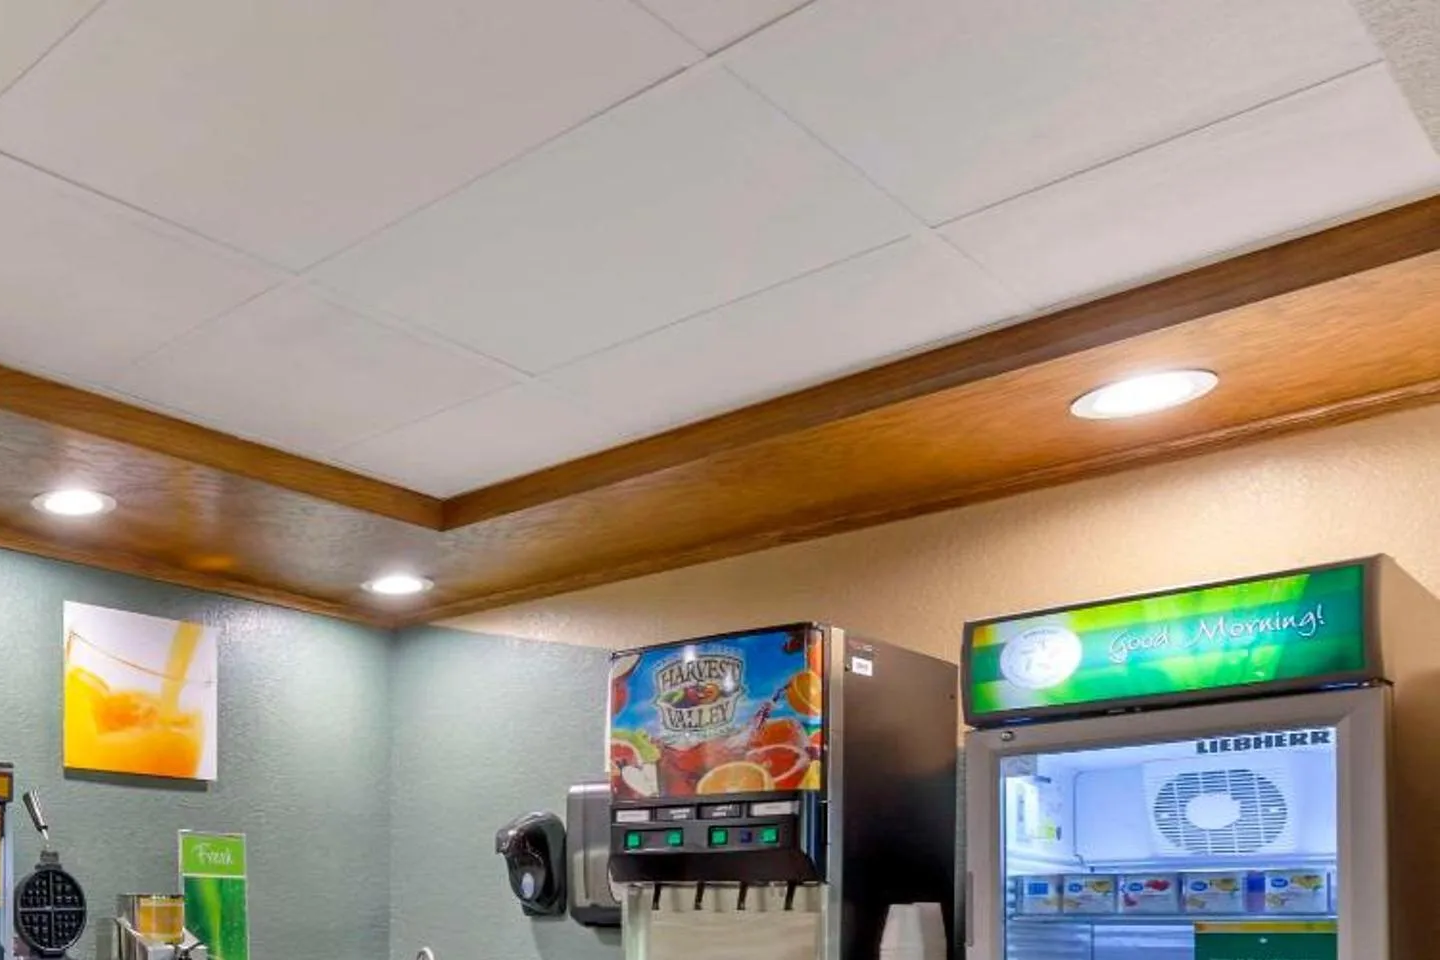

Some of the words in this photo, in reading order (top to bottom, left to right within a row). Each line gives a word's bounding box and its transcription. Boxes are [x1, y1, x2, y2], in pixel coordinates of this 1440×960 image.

[1107, 623, 1170, 663] Good
[1184, 603, 1326, 650] Morning!
[661, 657, 742, 689] HARVEST
[666, 700, 731, 729] VALLEY
[1196, 730, 1332, 755] LIEBHERR
[191, 842, 234, 865] Fresh
